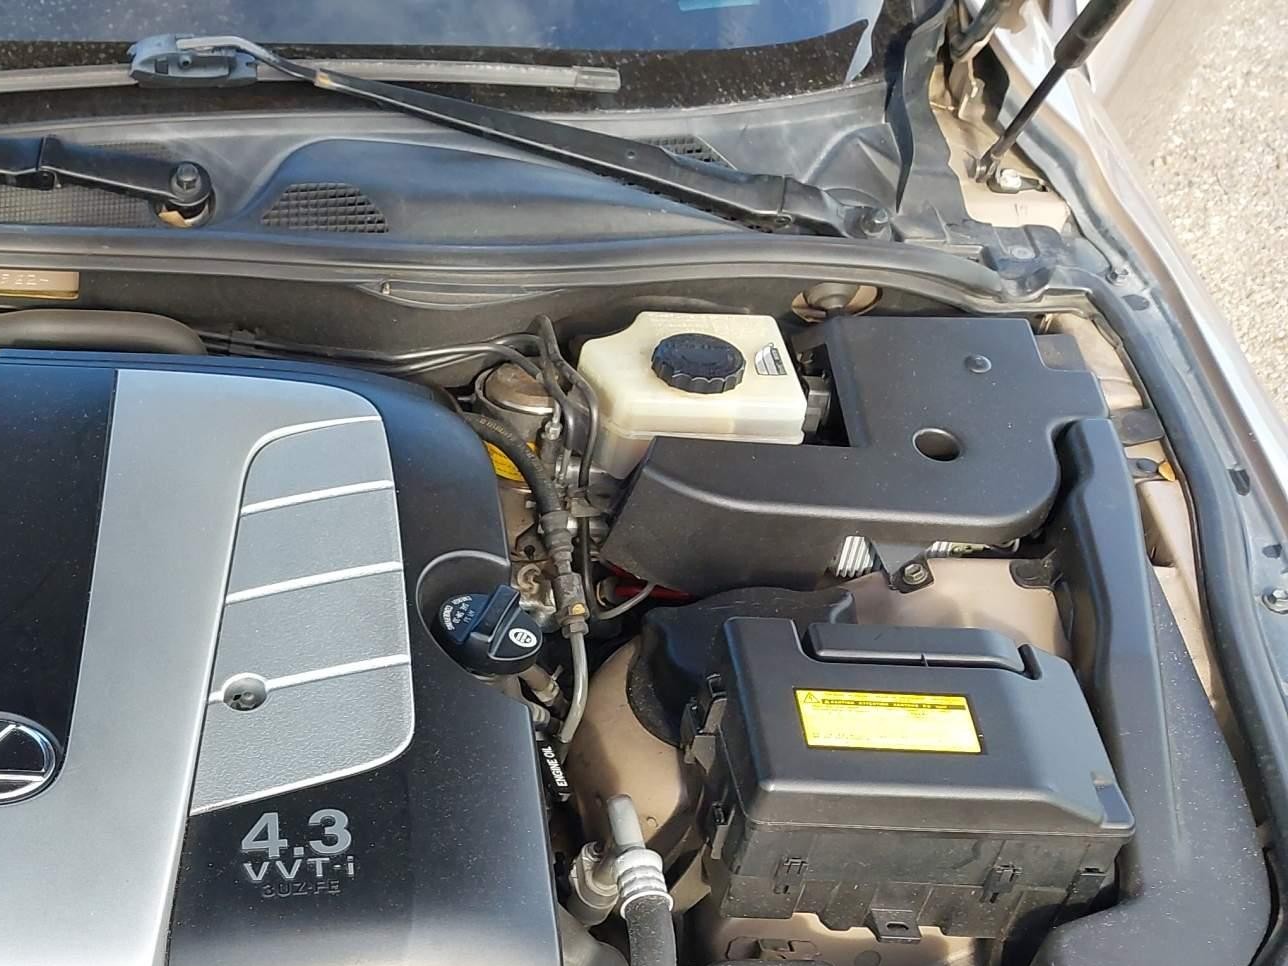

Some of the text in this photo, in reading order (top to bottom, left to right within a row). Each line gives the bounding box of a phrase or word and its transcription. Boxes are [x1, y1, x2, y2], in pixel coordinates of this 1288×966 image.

[241, 808, 352, 859] 4.3
[243, 856, 355, 882] VVT-i
[262, 880, 341, 898] 3UZ-FE
